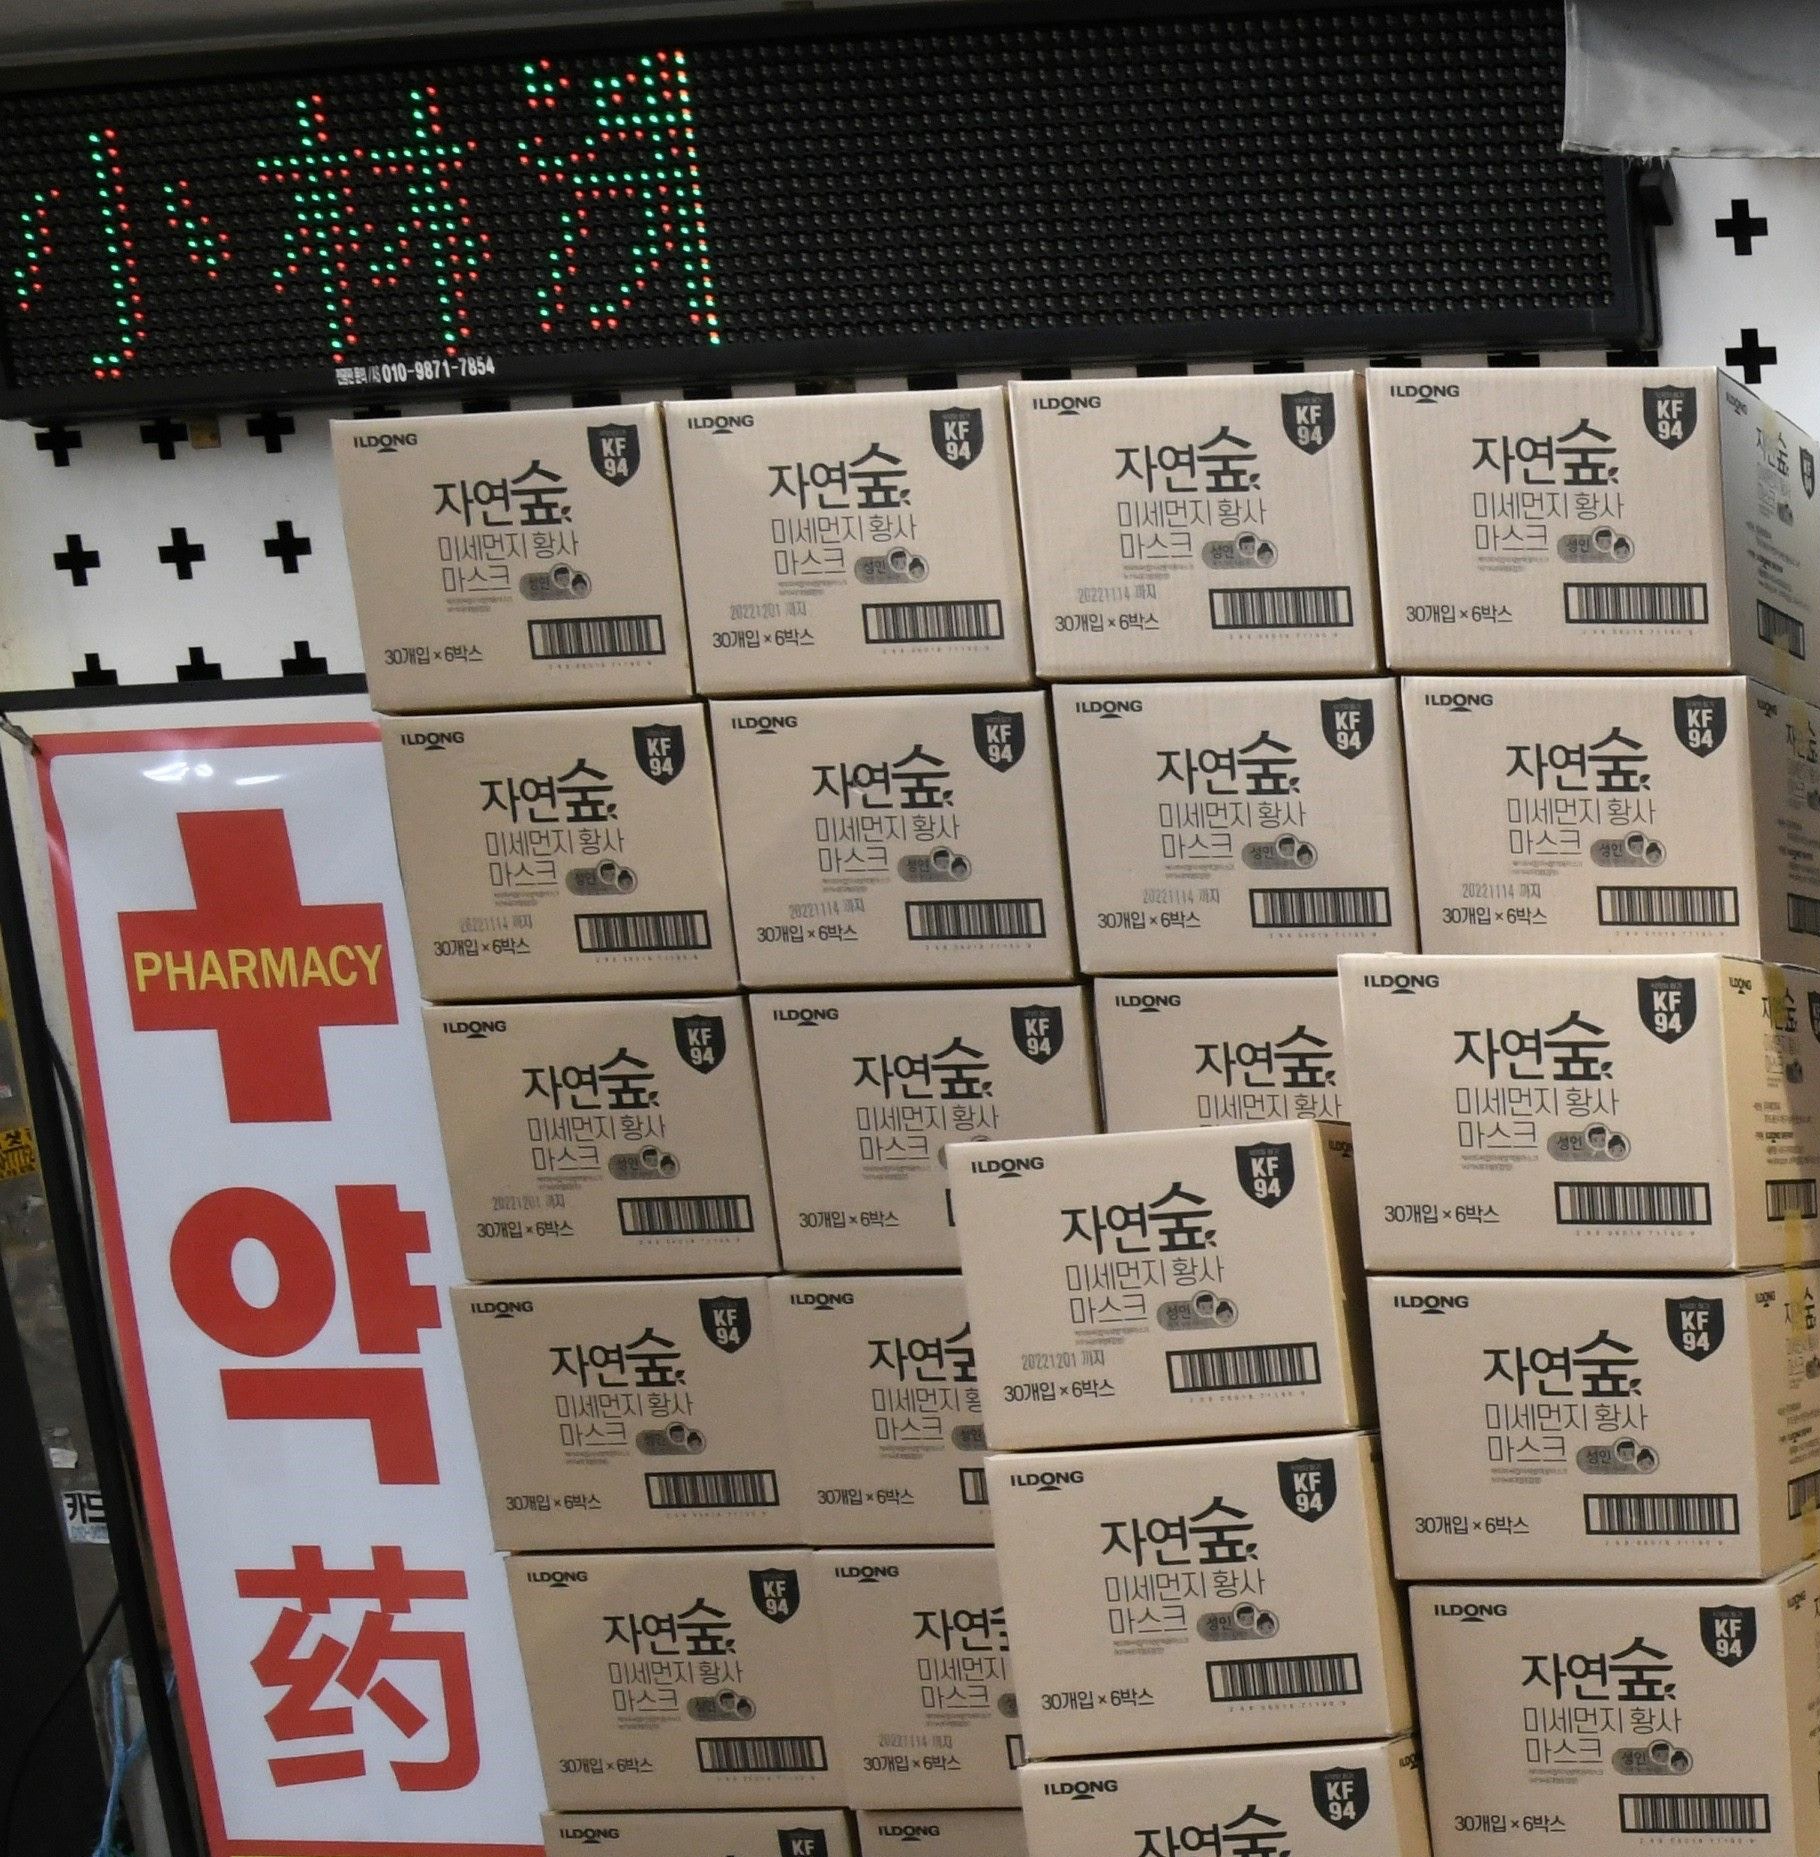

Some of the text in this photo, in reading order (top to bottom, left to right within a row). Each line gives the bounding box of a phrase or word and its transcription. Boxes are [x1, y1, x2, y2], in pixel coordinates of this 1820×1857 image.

[381, 355, 495, 384] 010-9871-7854
[1033, 395, 1101, 410] ILDONG
[1296, 404, 1322, 424] KF
[1296, 424, 1323, 447] 94
[1115, 426, 1260, 493] 자연숲
[1117, 498, 1268, 528] 미세먼지 황사
[1119, 531, 1194, 561] 마스크
[1054, 610, 1161, 633] 30개입 6박스
[134, 942, 384, 993] PHARMACY
[1364, 973, 1440, 990] ILDONG
[1453, 1010, 1613, 1082] 자연숲
[1454, 1087, 1619, 1118] 미세먼지 황사
[1457, 1122, 1539, 1151] 마스크
[971, 1156, 1045, 1175] ILDONG
[1061, 1181, 1217, 1255] 자연숲
[1384, 1203, 1500, 1225] 30개입 6박스
[170, 1184, 443, 1486] 약
[236, 1545, 482, 1793] 药
